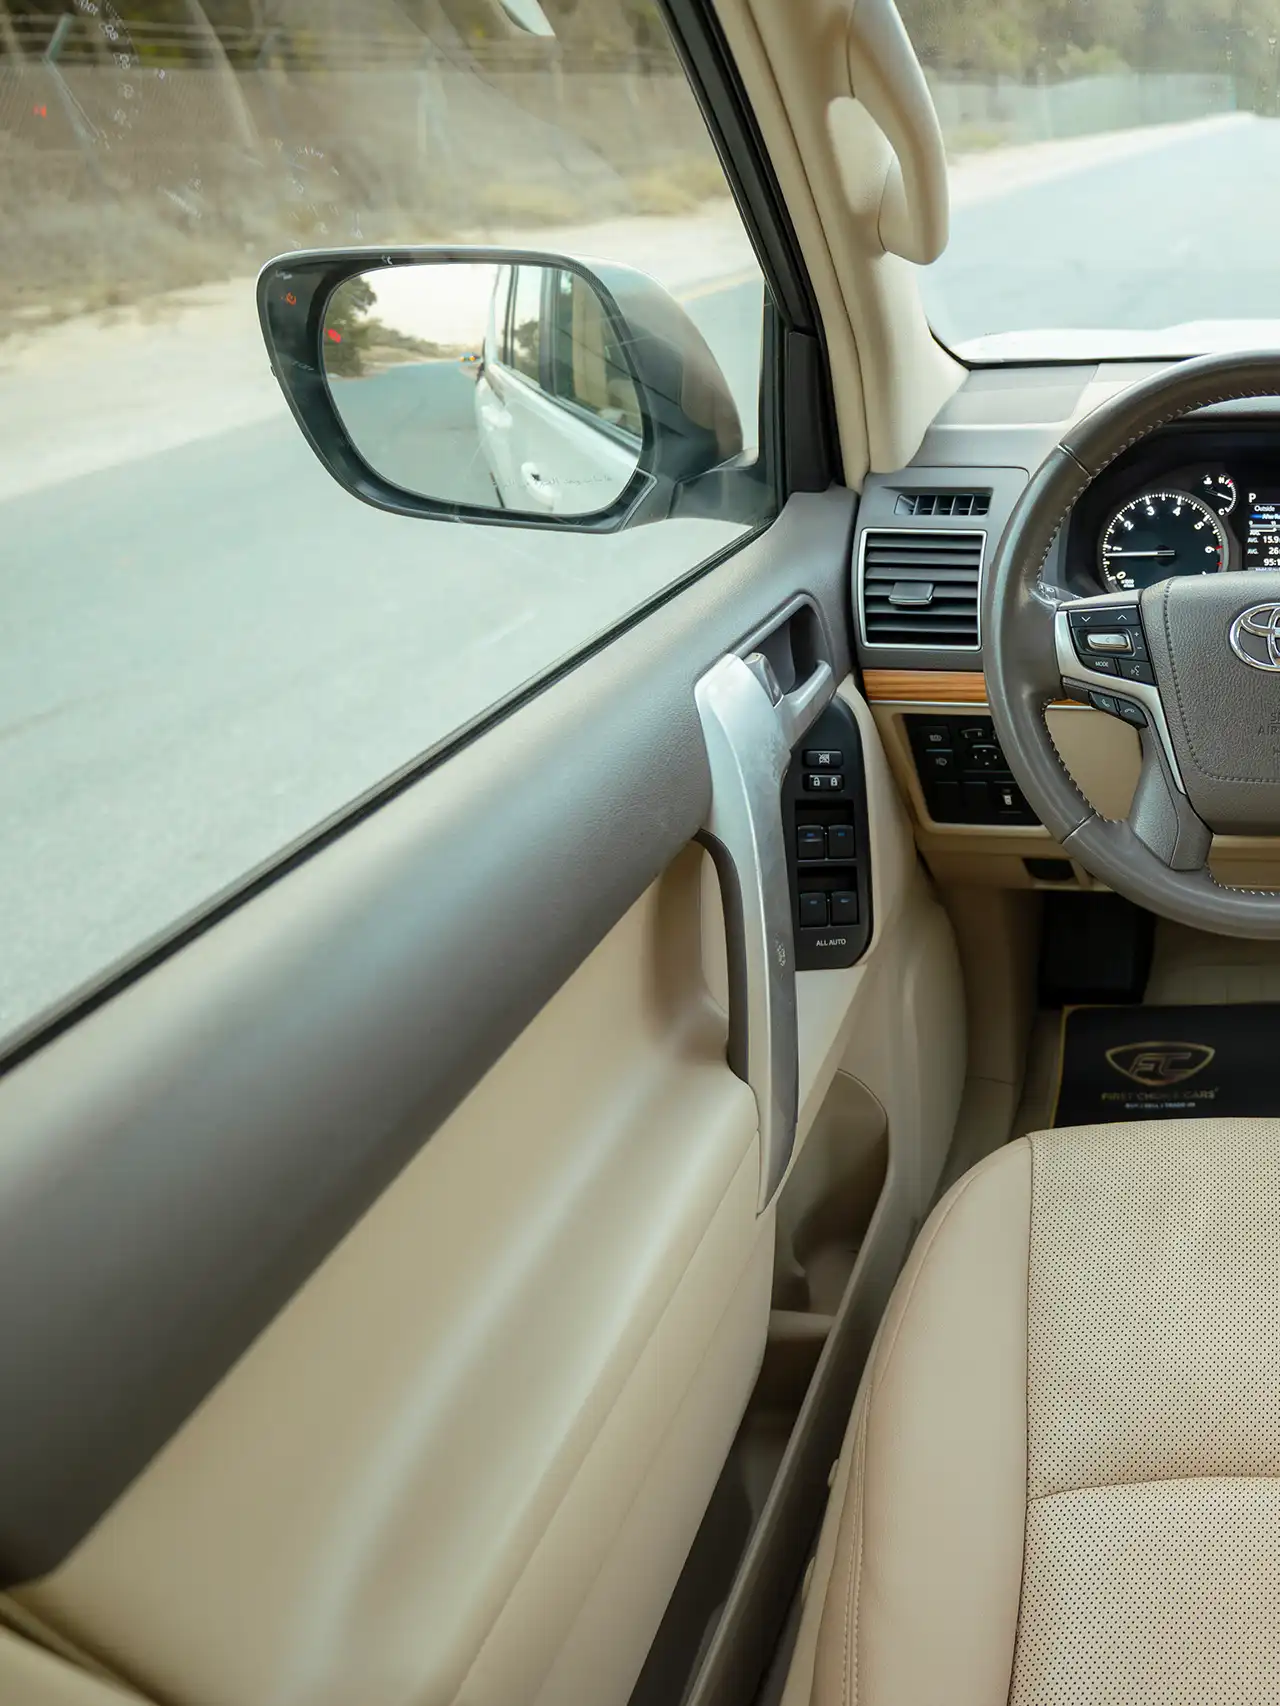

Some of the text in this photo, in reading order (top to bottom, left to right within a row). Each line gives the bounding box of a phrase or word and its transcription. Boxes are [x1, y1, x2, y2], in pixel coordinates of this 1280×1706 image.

[1248, 492, 1256, 502] P
[1146, 506, 1154, 516] 3
[1172, 506, 1181, 516] 4
[1124, 520, 1134, 530] 2
[1194, 521, 1204, 530] 5
[1116, 571, 1126, 580] 0
